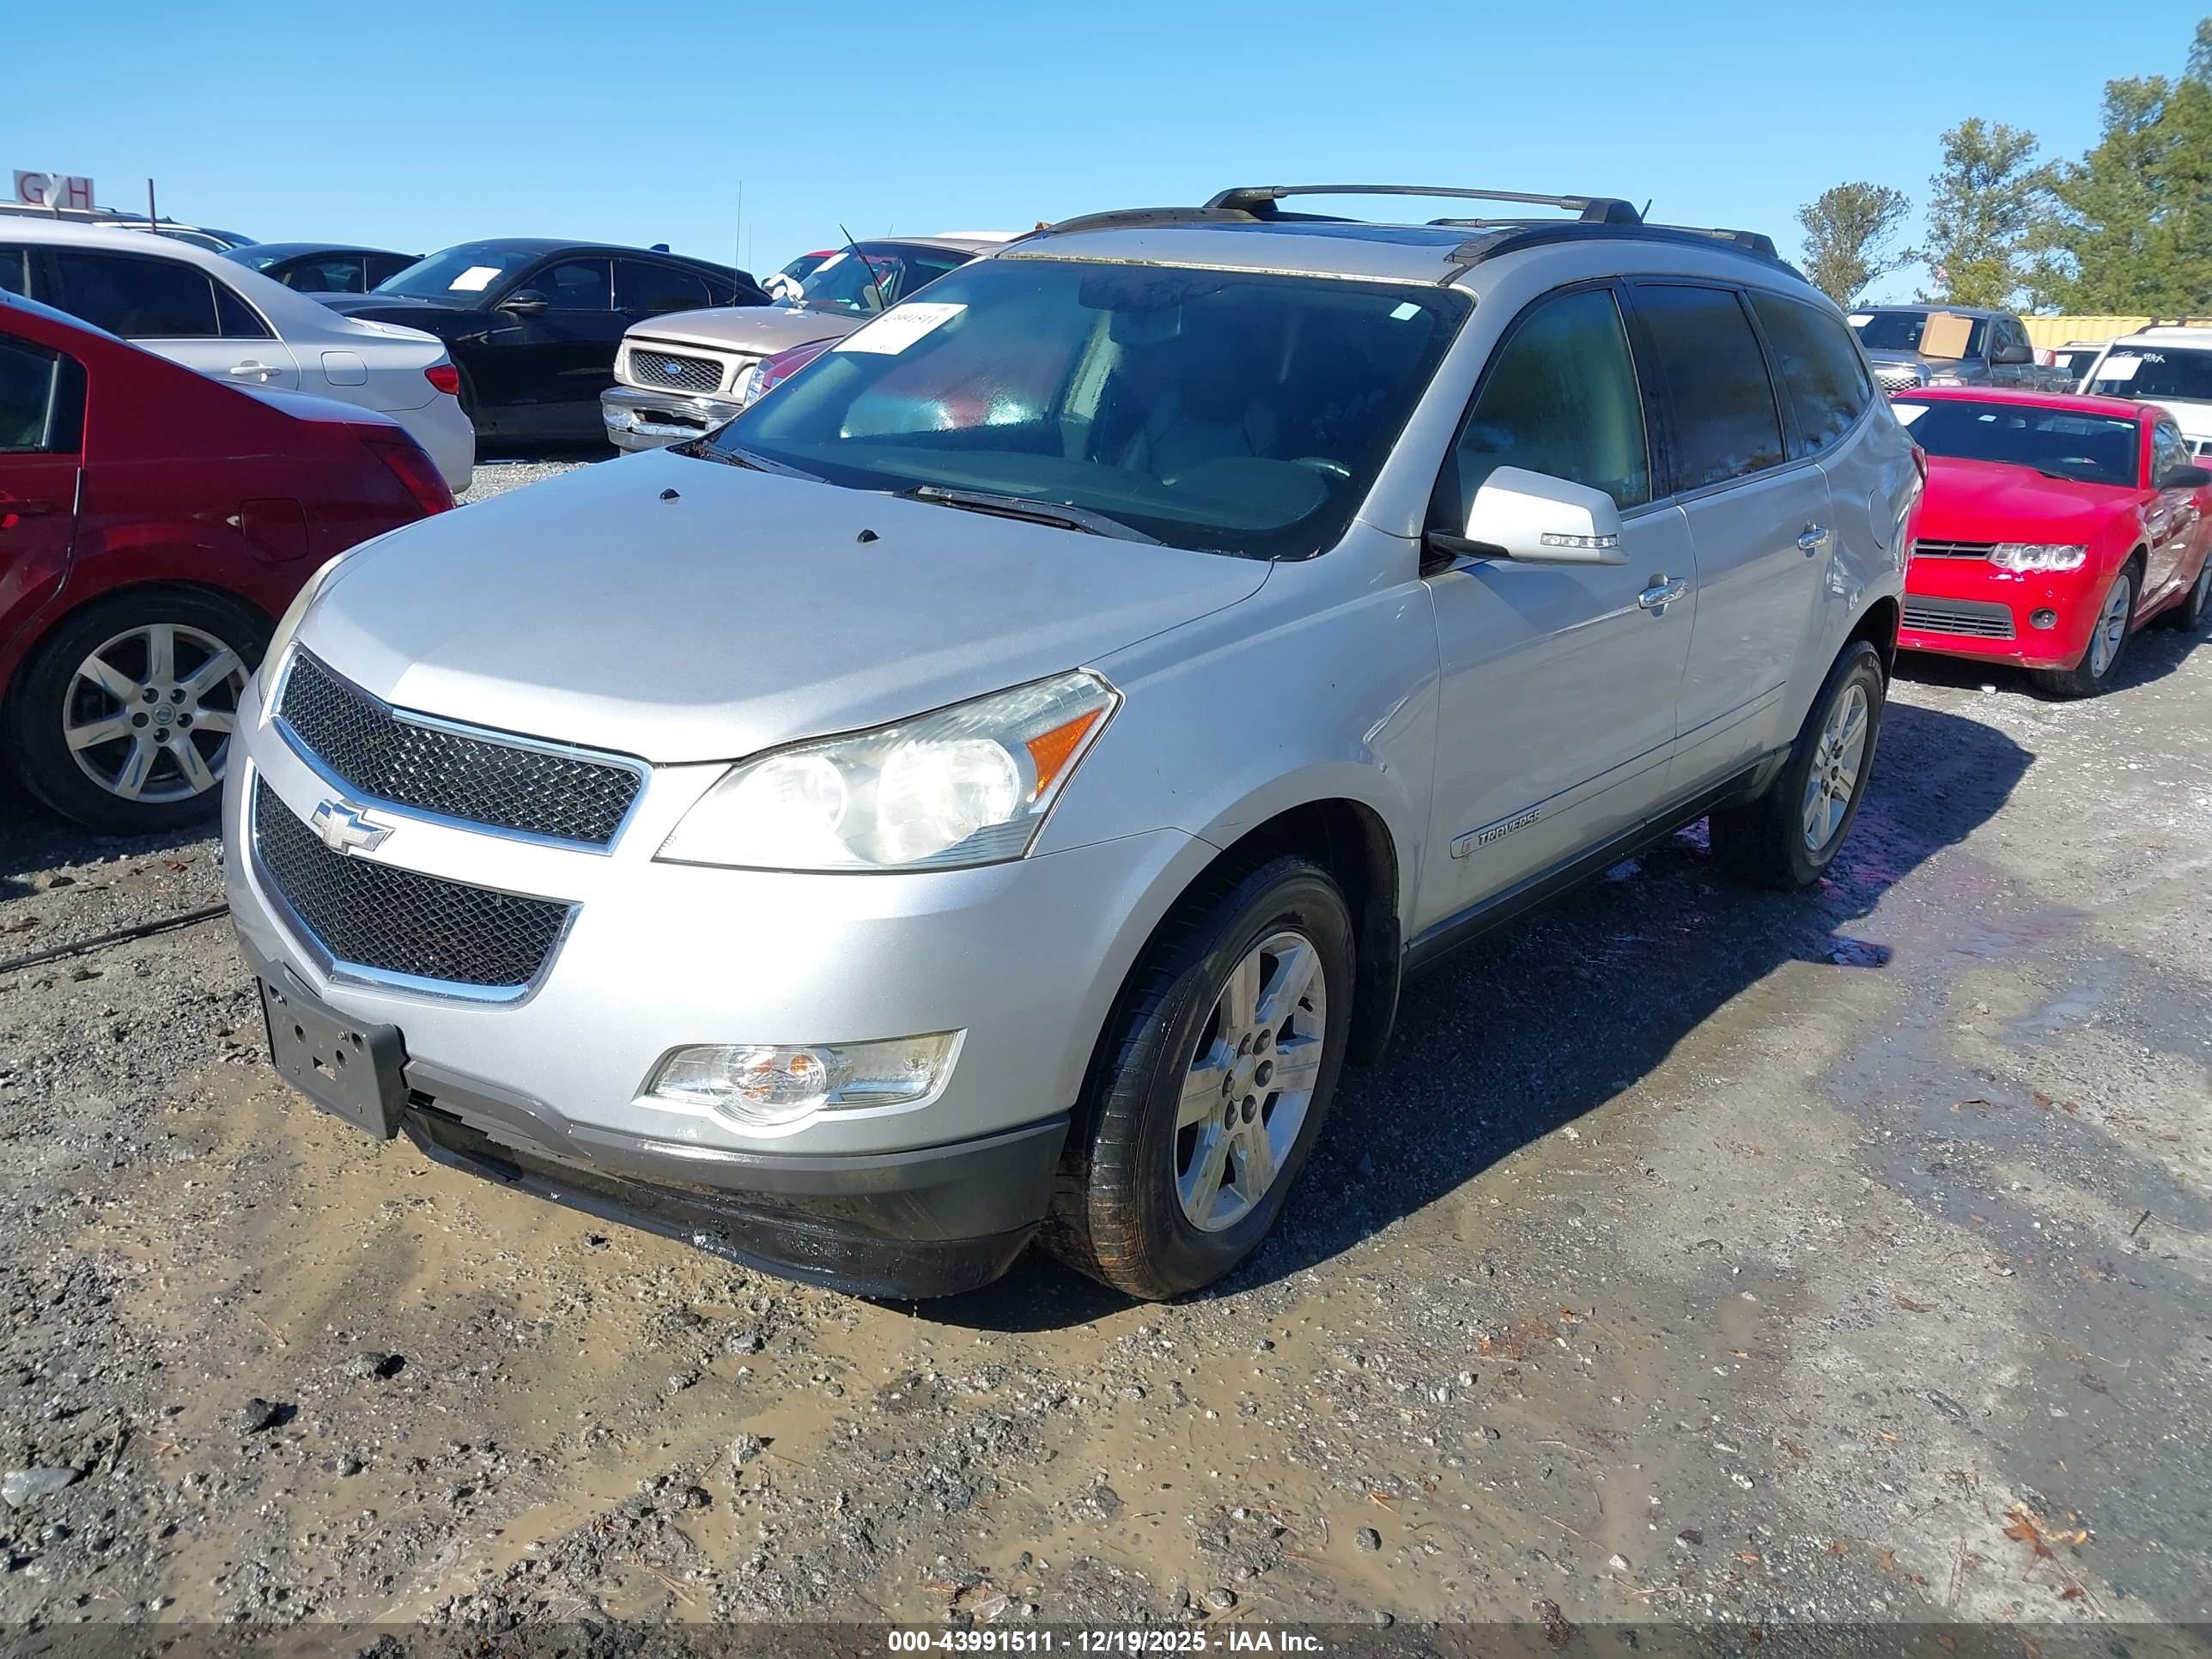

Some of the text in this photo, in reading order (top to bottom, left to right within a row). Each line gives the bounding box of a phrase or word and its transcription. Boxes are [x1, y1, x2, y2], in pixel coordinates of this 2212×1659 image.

[20, 173, 89, 210] G H
[1478, 809, 1541, 846] TRAVERSE
